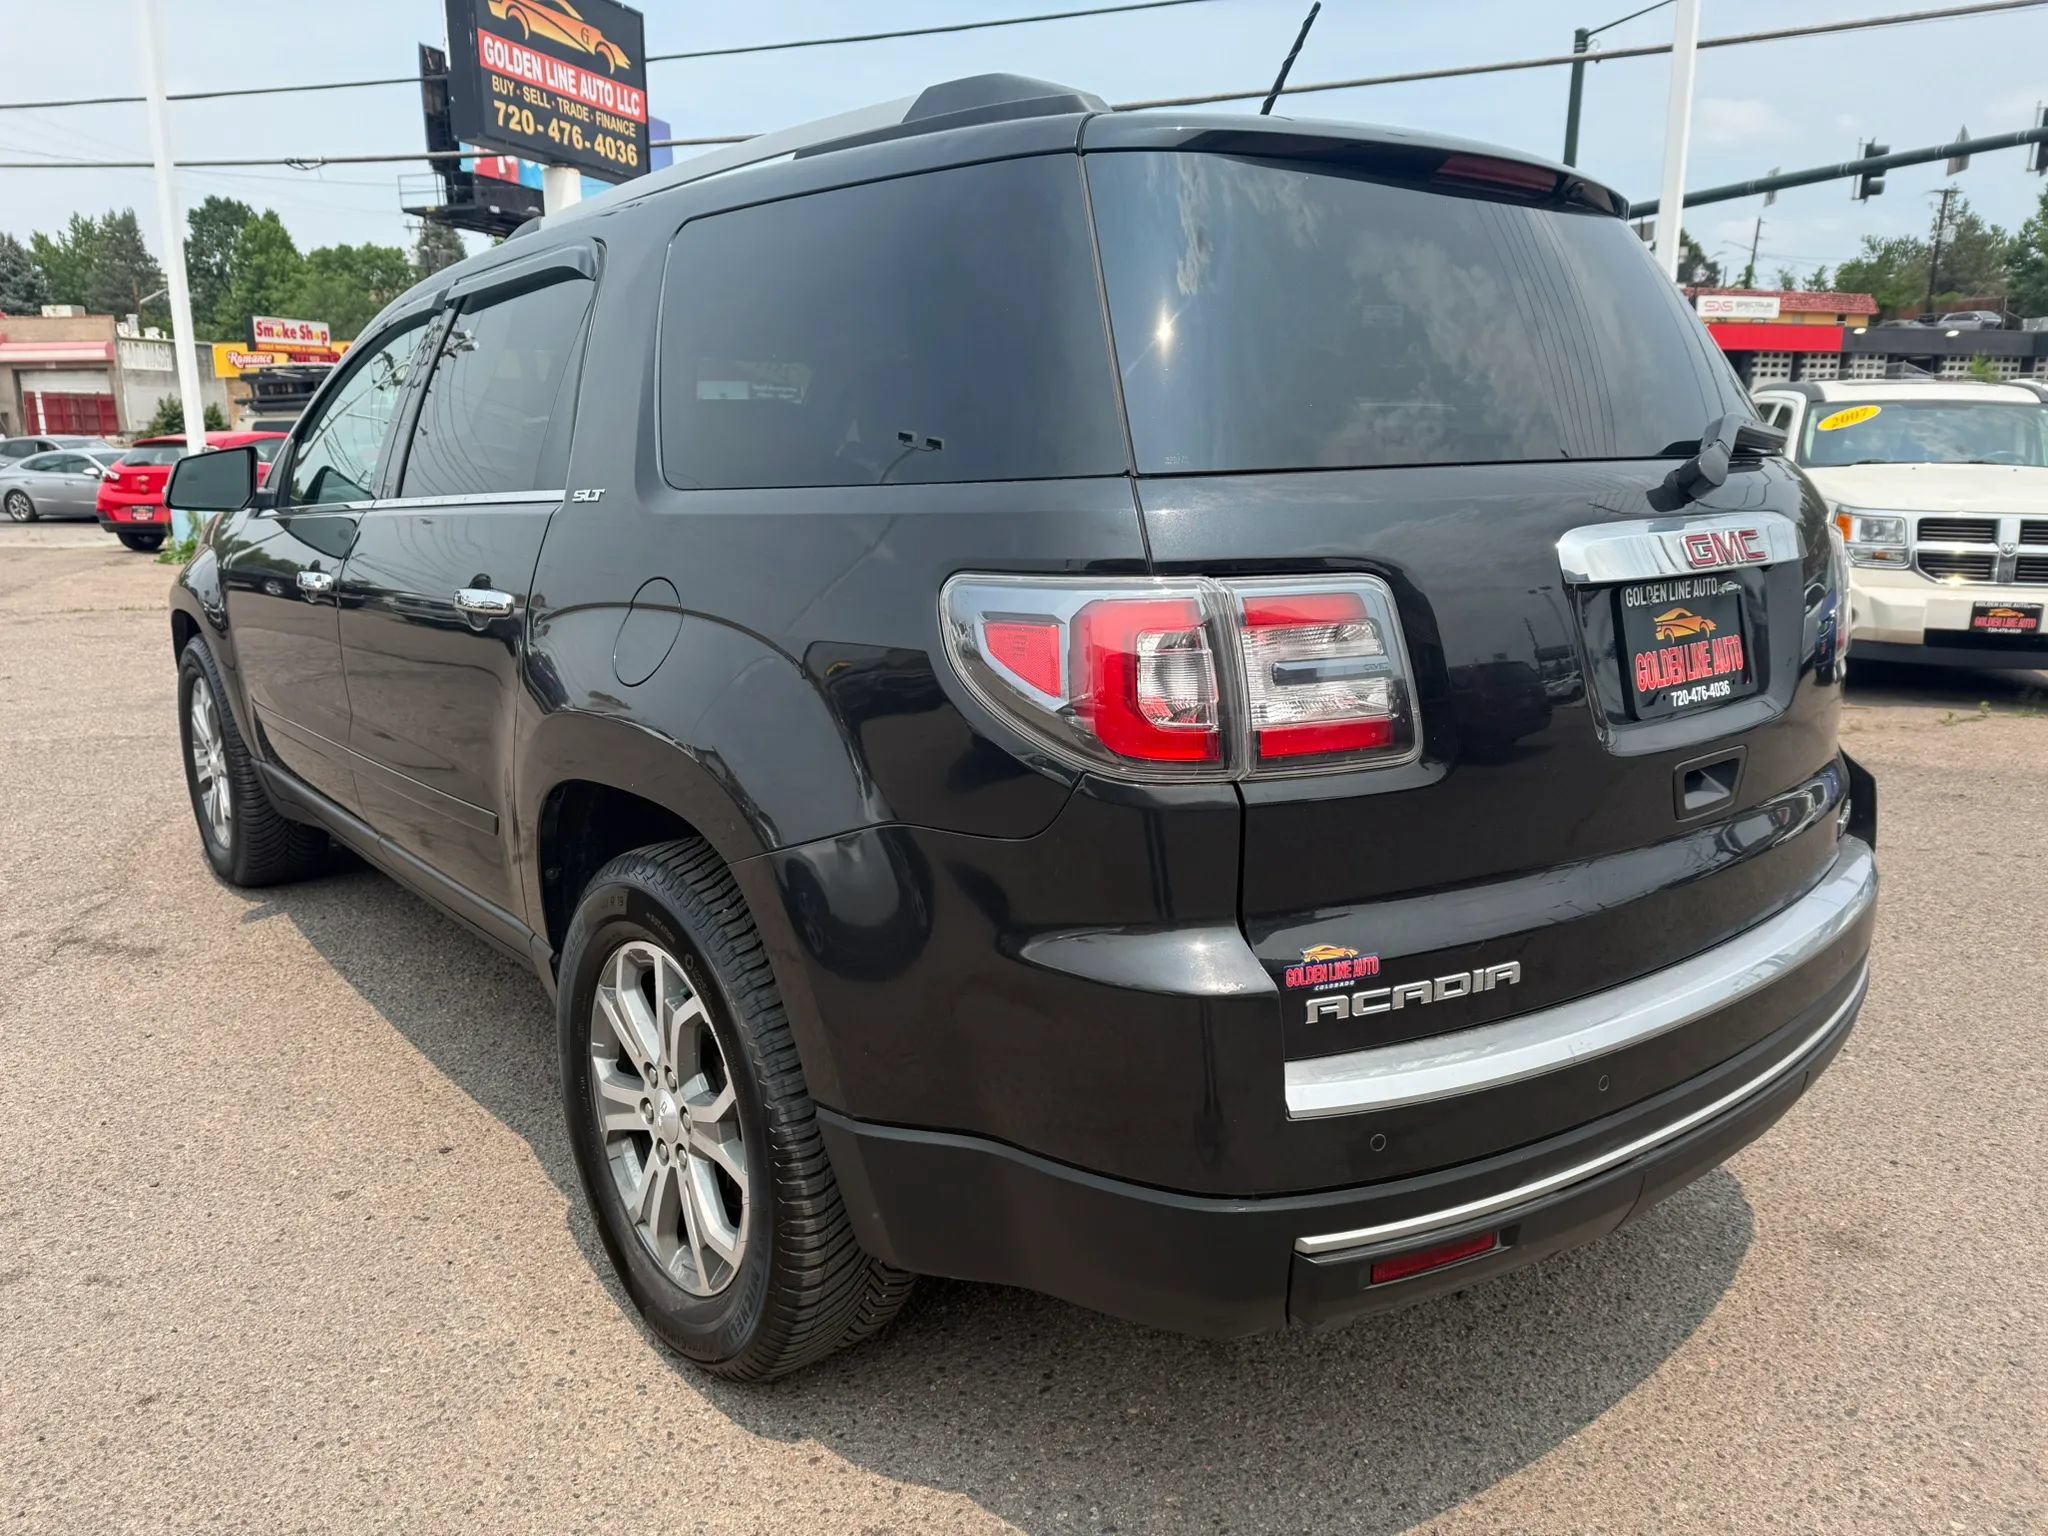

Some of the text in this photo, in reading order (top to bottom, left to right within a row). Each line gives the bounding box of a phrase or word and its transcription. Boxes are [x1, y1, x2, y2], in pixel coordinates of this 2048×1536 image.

[483, 36, 641, 117] GOLDEN LINE AUTO LLC
[492, 75, 636, 137] BUY SELL TRADE FINANCE
[256, 321, 328, 344] Smoke Shop
[1831, 408, 1868, 427] 2007
[572, 488, 606, 503] SLT
[1682, 529, 1768, 569] GMC
[1625, 578, 1718, 608] GOLDEN LINE AUTO
[1635, 634, 1744, 692] GOLDEN LINE AUTO
[1670, 680, 1731, 707] 720-476-4036
[1285, 955, 1380, 988] GOLDEN LINE AUTO
[1305, 961, 1521, 1025] ACADIA
